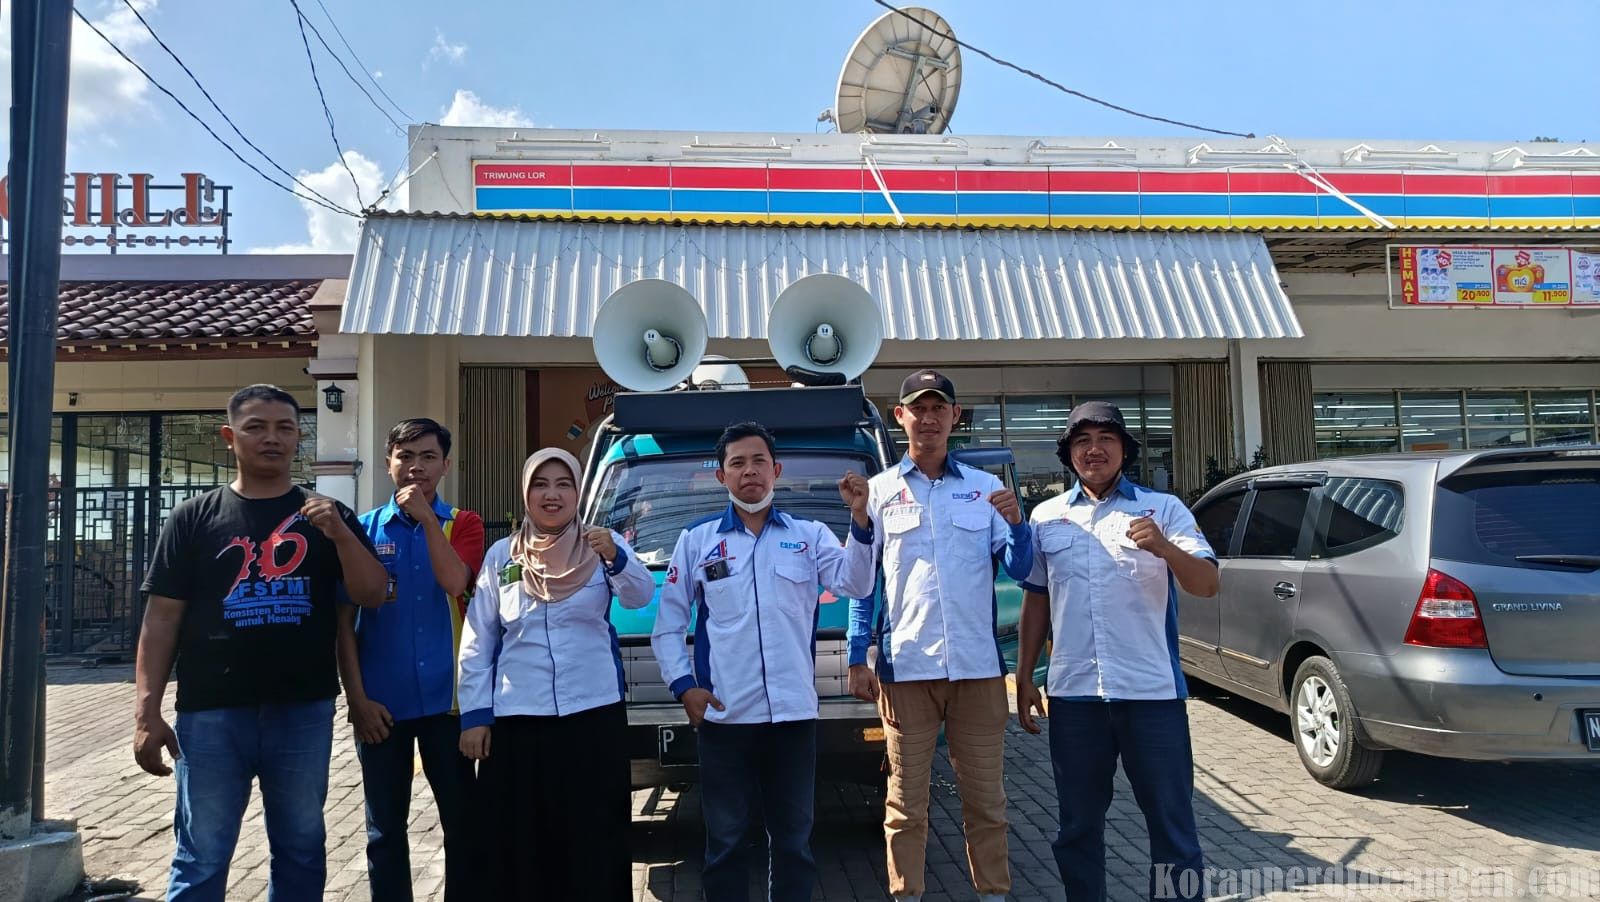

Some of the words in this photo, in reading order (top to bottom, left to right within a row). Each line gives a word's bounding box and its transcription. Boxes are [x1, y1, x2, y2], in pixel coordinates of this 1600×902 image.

[1402, 247, 1414, 303] HEMAT
[588, 383, 626, 401] Welco
[223, 607, 271, 620] Konsisten
[1493, 603, 1528, 612] GRAND
[1530, 602, 1563, 611] LIVINA
[235, 615, 265, 628] untuk
[662, 729, 675, 753] P
